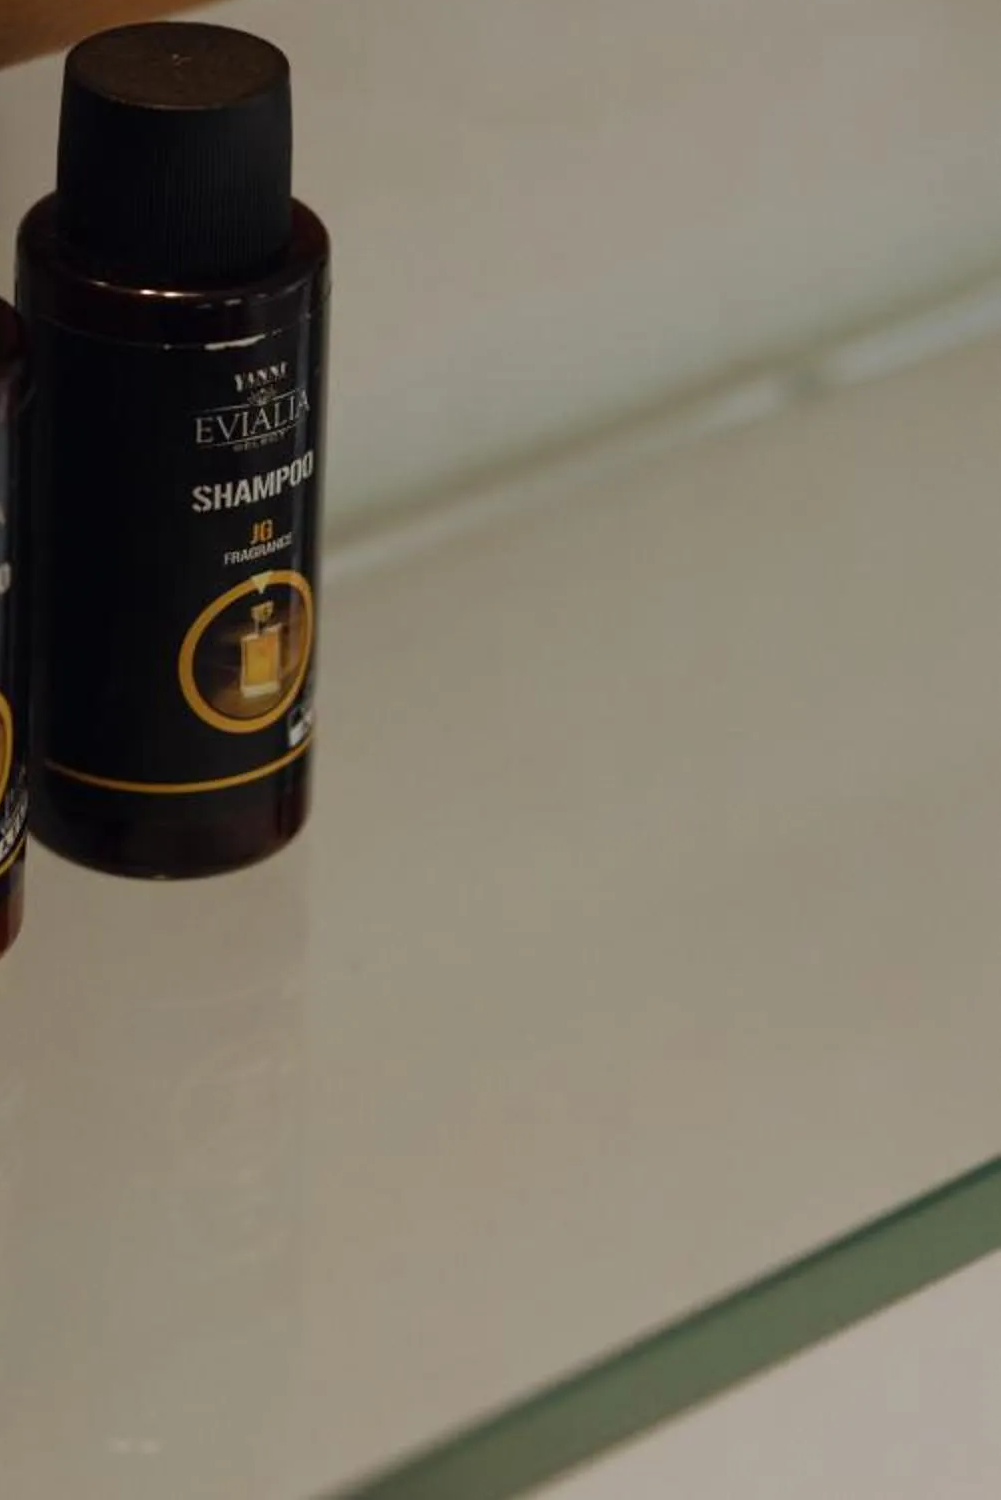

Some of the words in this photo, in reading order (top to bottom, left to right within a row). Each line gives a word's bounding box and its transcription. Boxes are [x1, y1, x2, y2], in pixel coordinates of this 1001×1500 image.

[195, 387, 310, 444] EVIALIA
[191, 451, 314, 513] SHAMPOO
[223, 532, 293, 565] FRAGRANCE
